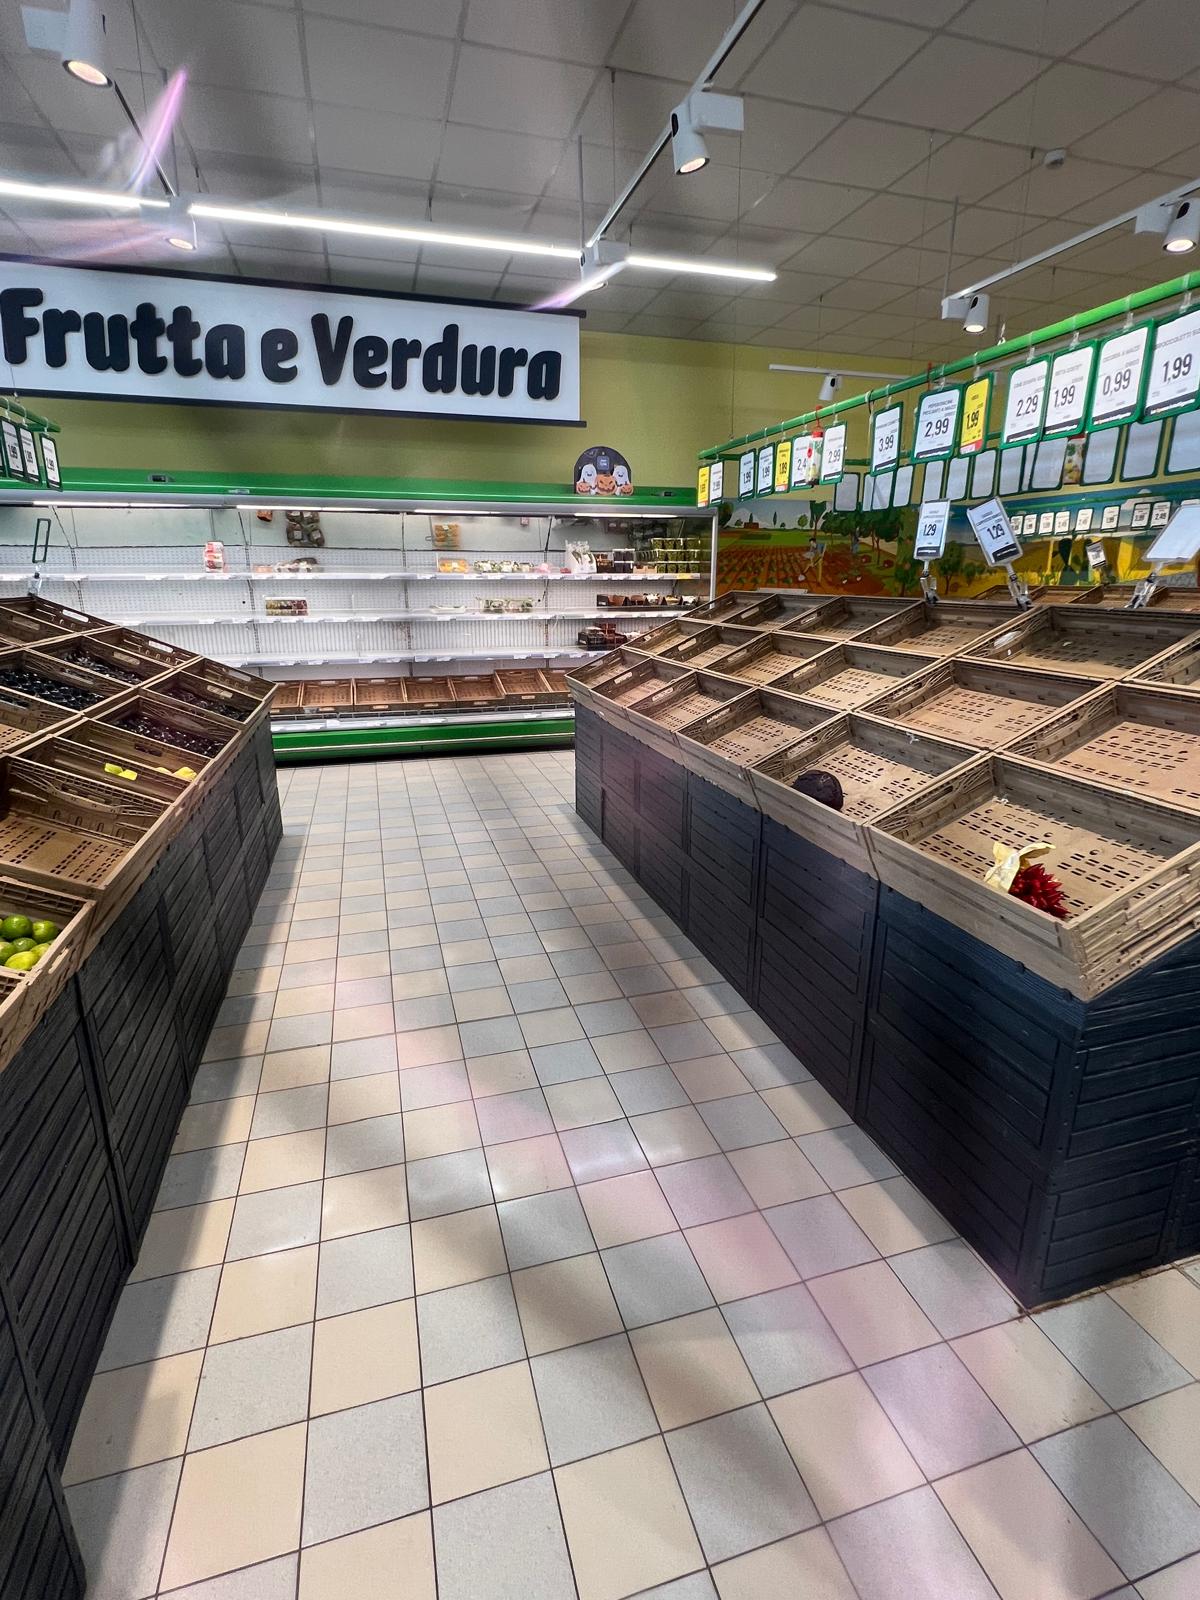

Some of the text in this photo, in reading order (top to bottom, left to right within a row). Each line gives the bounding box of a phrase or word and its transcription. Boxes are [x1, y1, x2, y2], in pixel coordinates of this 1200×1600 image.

[0, 287, 562, 400] Frutta e Verdura
[1162, 353, 1193, 384] 1,99
[1102, 368, 1132, 396] 0,99
[1016, 394, 1039, 417] 2,29
[1054, 385, 1076, 408] 1,99
[924, 417, 950, 438] 2,99
[966, 410, 980, 430] 1,99
[878, 434, 895, 452] 3,99
[922, 523, 937, 536] 1,29
[987, 523, 1006, 540] 1,29
